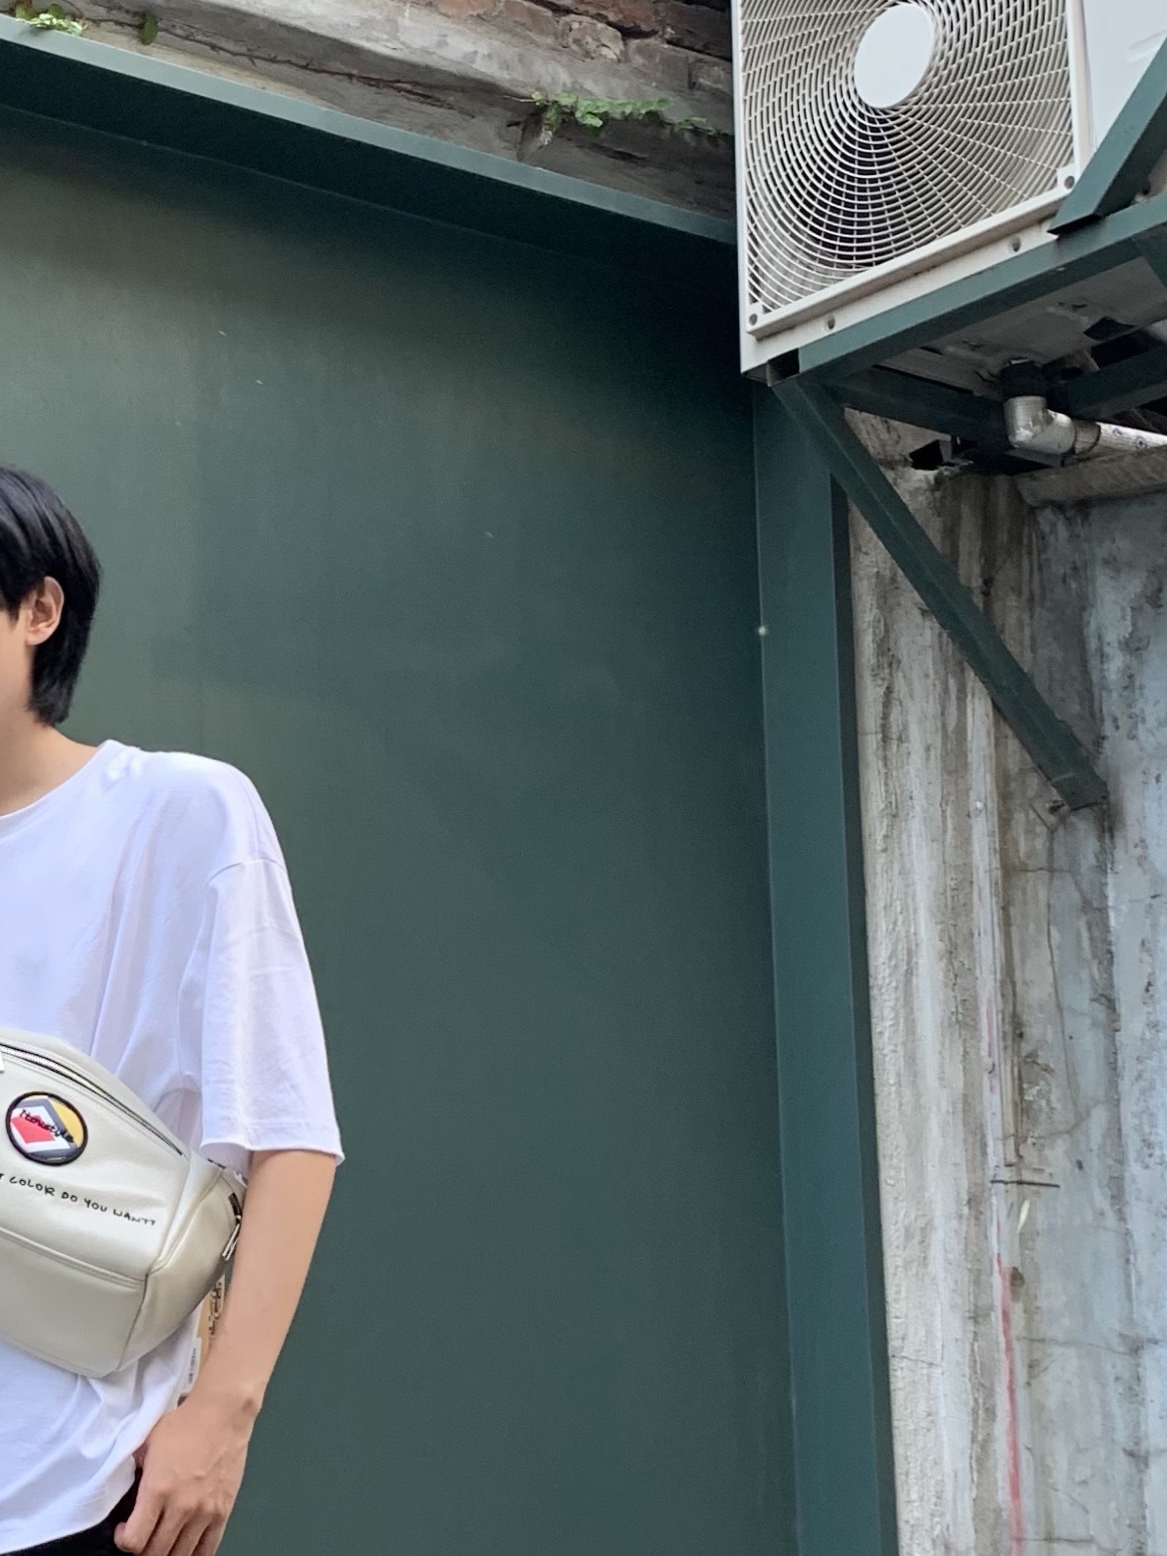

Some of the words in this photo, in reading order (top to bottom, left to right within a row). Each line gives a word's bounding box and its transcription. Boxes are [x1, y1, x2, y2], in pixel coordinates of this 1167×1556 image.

[10, 1176, 55, 1196] COLOR
[61, 1192, 78, 1202] DO
[84, 1198, 106, 1212] YOU
